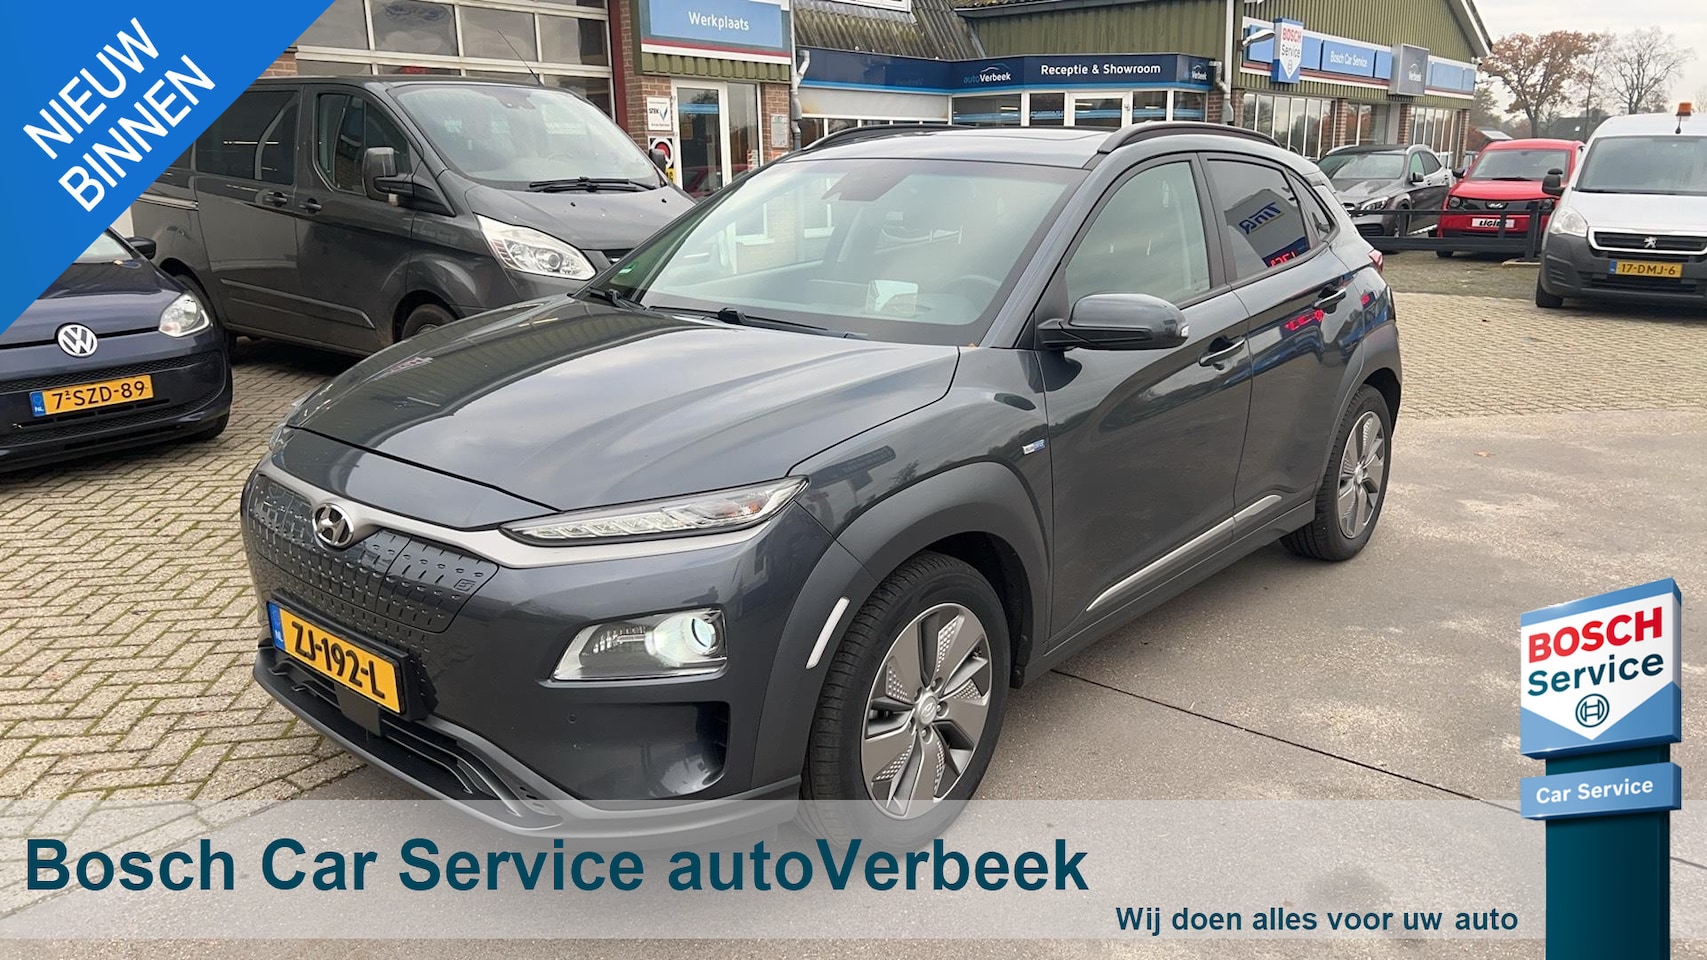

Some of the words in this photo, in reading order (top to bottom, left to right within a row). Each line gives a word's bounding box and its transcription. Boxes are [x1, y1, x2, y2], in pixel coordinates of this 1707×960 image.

[688, 11, 749, 31] Werkplaats
[1282, 27, 1301, 43] BOSCH
[1281, 44, 1300, 58] Service
[1330, 51, 1344, 64] Bosch
[1353, 54, 1368, 67] Service
[1041, 65, 1088, 76] Receptie
[1091, 64, 1100, 74] &
[1103, 64, 1161, 74] Showroom
[1622, 263, 1676, 275] 17-DMJ-6
[291, 620, 386, 700] ZJ-192-L
